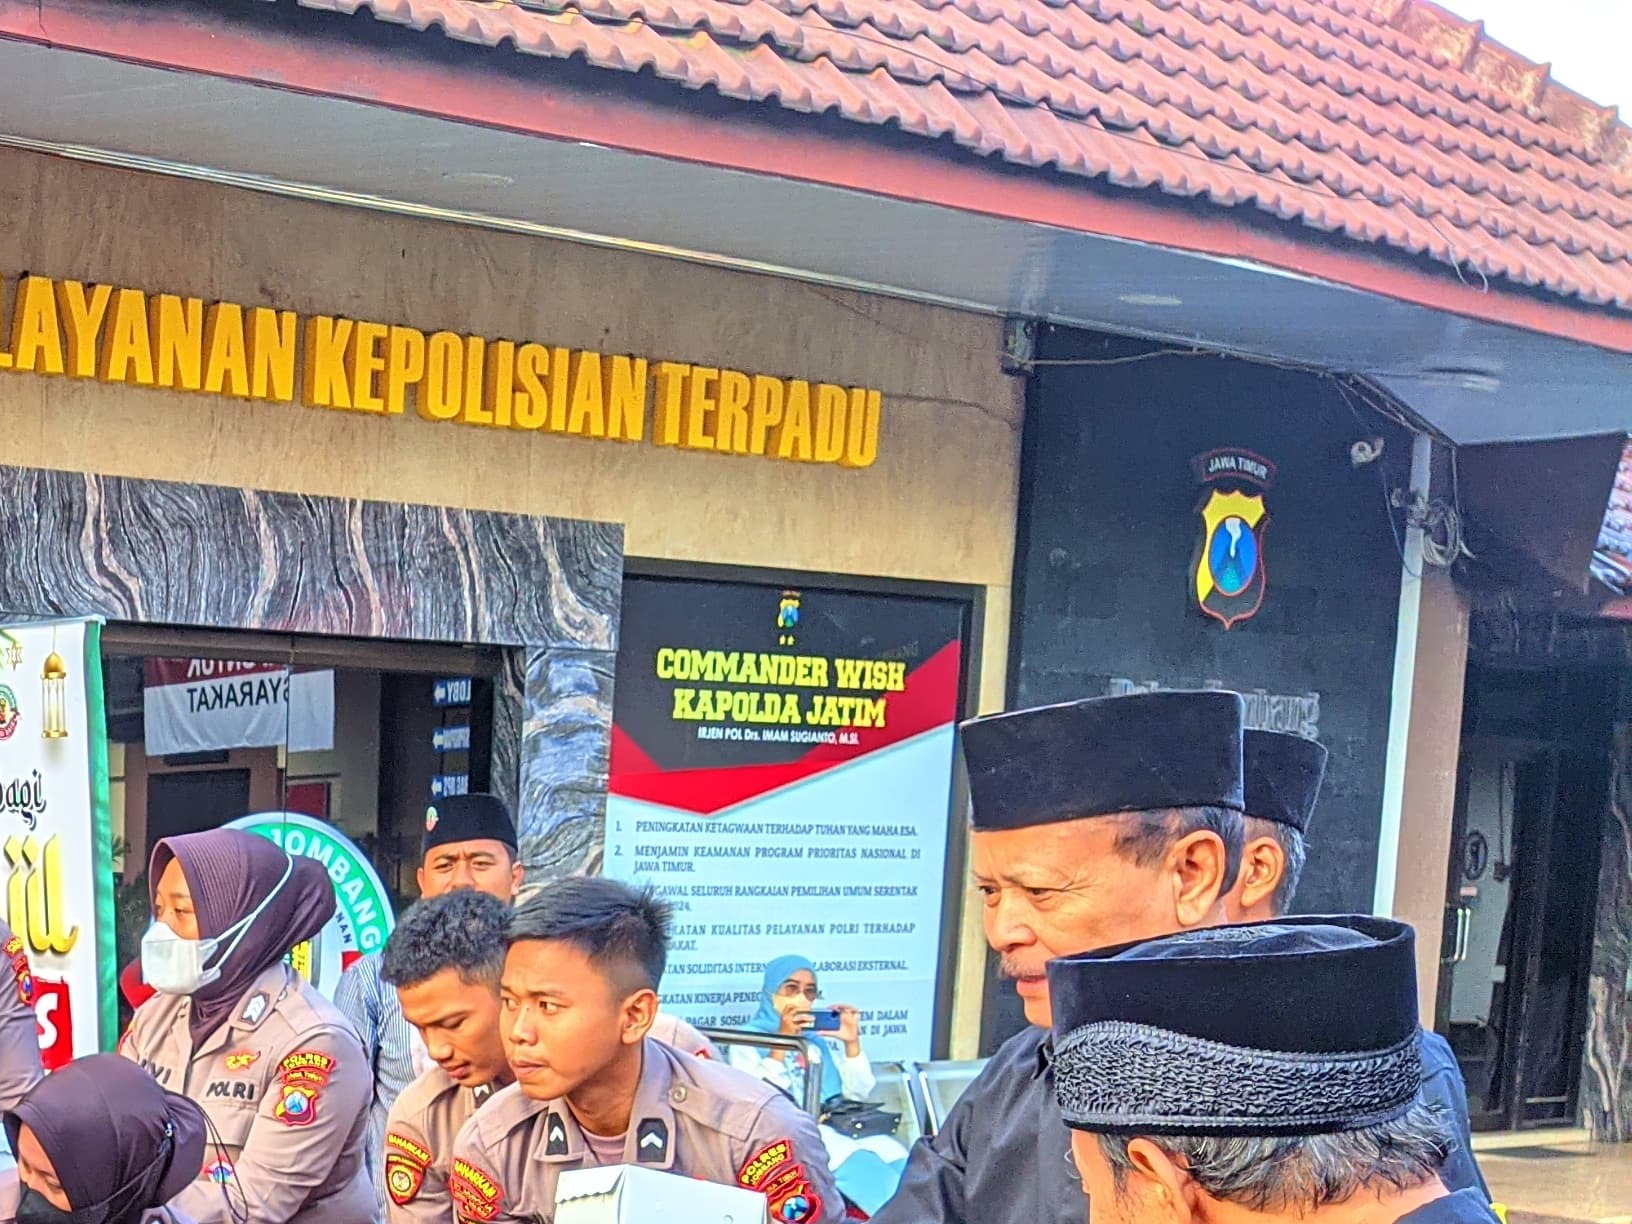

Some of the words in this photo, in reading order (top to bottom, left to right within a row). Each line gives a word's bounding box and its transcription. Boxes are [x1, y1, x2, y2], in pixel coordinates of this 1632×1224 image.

[304, 315, 648, 441] KEPOLISIAN
[652, 361, 882, 469] TERPADU
[1209, 456, 1236, 472] JAWA
[1238, 457, 1267, 480] TIMUR
[657, 648, 828, 687] COMMANDER
[835, 659, 906, 691] WISH
[672, 688, 801, 723] KAPOLDA
[807, 696, 886, 727] JATIM
[636, 821, 703, 833] PENINGKATAN
[765, 823, 814, 834] TERHADAP
[816, 824, 846, 835] TUHAN
[847, 825, 871, 836] YANG
[872, 826, 899, 836] MAHA
[634, 845, 689, 859] MENJAMIN
[694, 846, 750, 857] KEAMANAN
[755, 847, 803, 858] PROGRAM
[808, 847, 857, 858] PRIORITAS
[860, 848, 907, 859] NASIONAL
[634, 861, 660, 874] JAWA
[691, 885, 733, 896] SELURUH
[735, 886, 789, 897] RANGKAIAN
[791, 886, 841, 896] PEMILIHAN
[843, 886, 872, 896] UMUM
[874, 886, 918, 896] SERENTAK
[711, 924, 761, 935] KUALITAS
[766, 924, 825, 935] PELAYANAN
[830, 923, 859, 934] POLRI
[864, 923, 916, 934] TERHADAP
[688, 963, 733, 974] SOLIDITAS
[877, 1010, 909, 1021] DALAM
[882, 1024, 907, 1037] JAWA
[741, 1144, 786, 1184] POLRES
